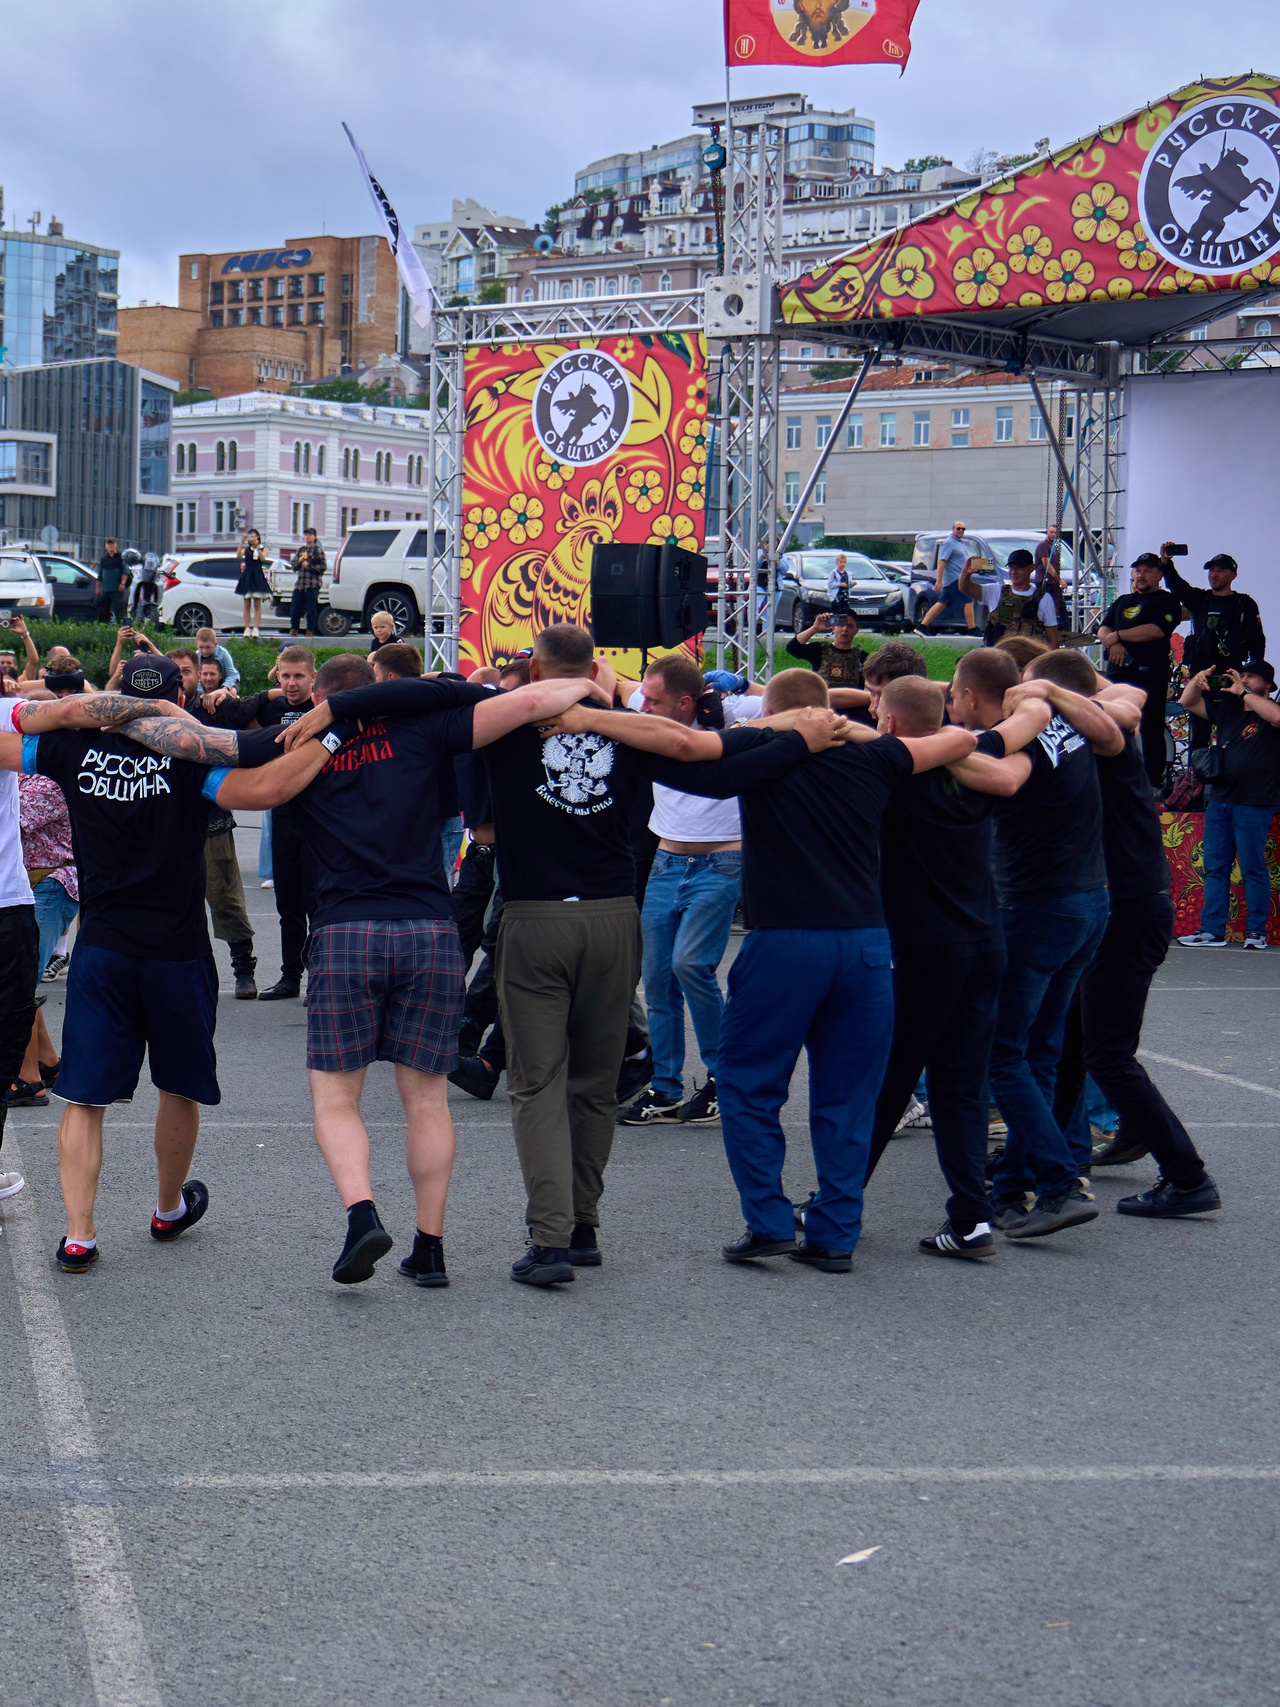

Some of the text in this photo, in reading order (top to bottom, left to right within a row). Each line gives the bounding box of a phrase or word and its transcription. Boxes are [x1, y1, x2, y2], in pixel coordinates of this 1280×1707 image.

[541, 355, 624, 394] РУССКАЯ
[544, 427, 620, 460] ОБЩИНА
[134, 678, 159, 689] STREETS
[81, 748, 172, 778] РУССКАЯ
[77, 772, 171, 801] ОБЩИНА
